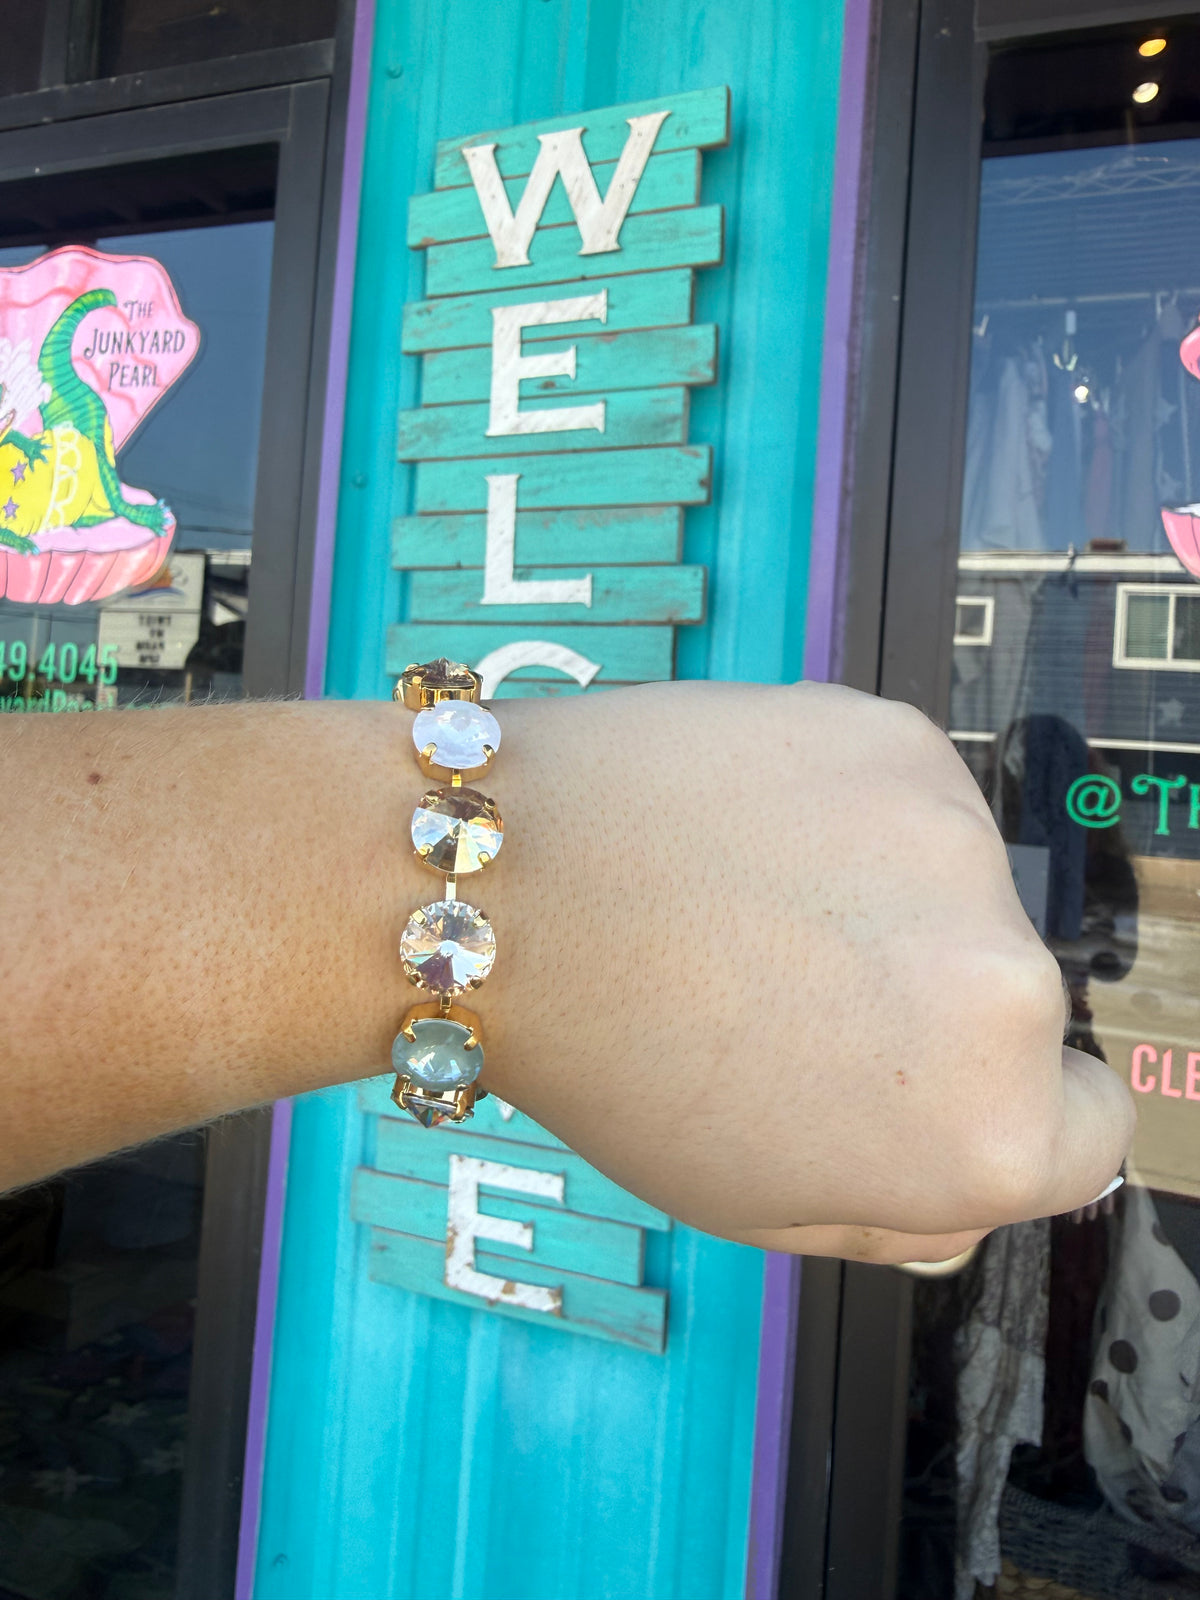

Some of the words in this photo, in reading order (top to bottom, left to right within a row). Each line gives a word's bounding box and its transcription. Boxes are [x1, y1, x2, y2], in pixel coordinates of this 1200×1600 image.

[123, 299, 153, 322] THE
[83, 327, 186, 361] JUNKYARD
[107, 361, 161, 393] PEARL
[1131, 1043, 1200, 1101] CLE
